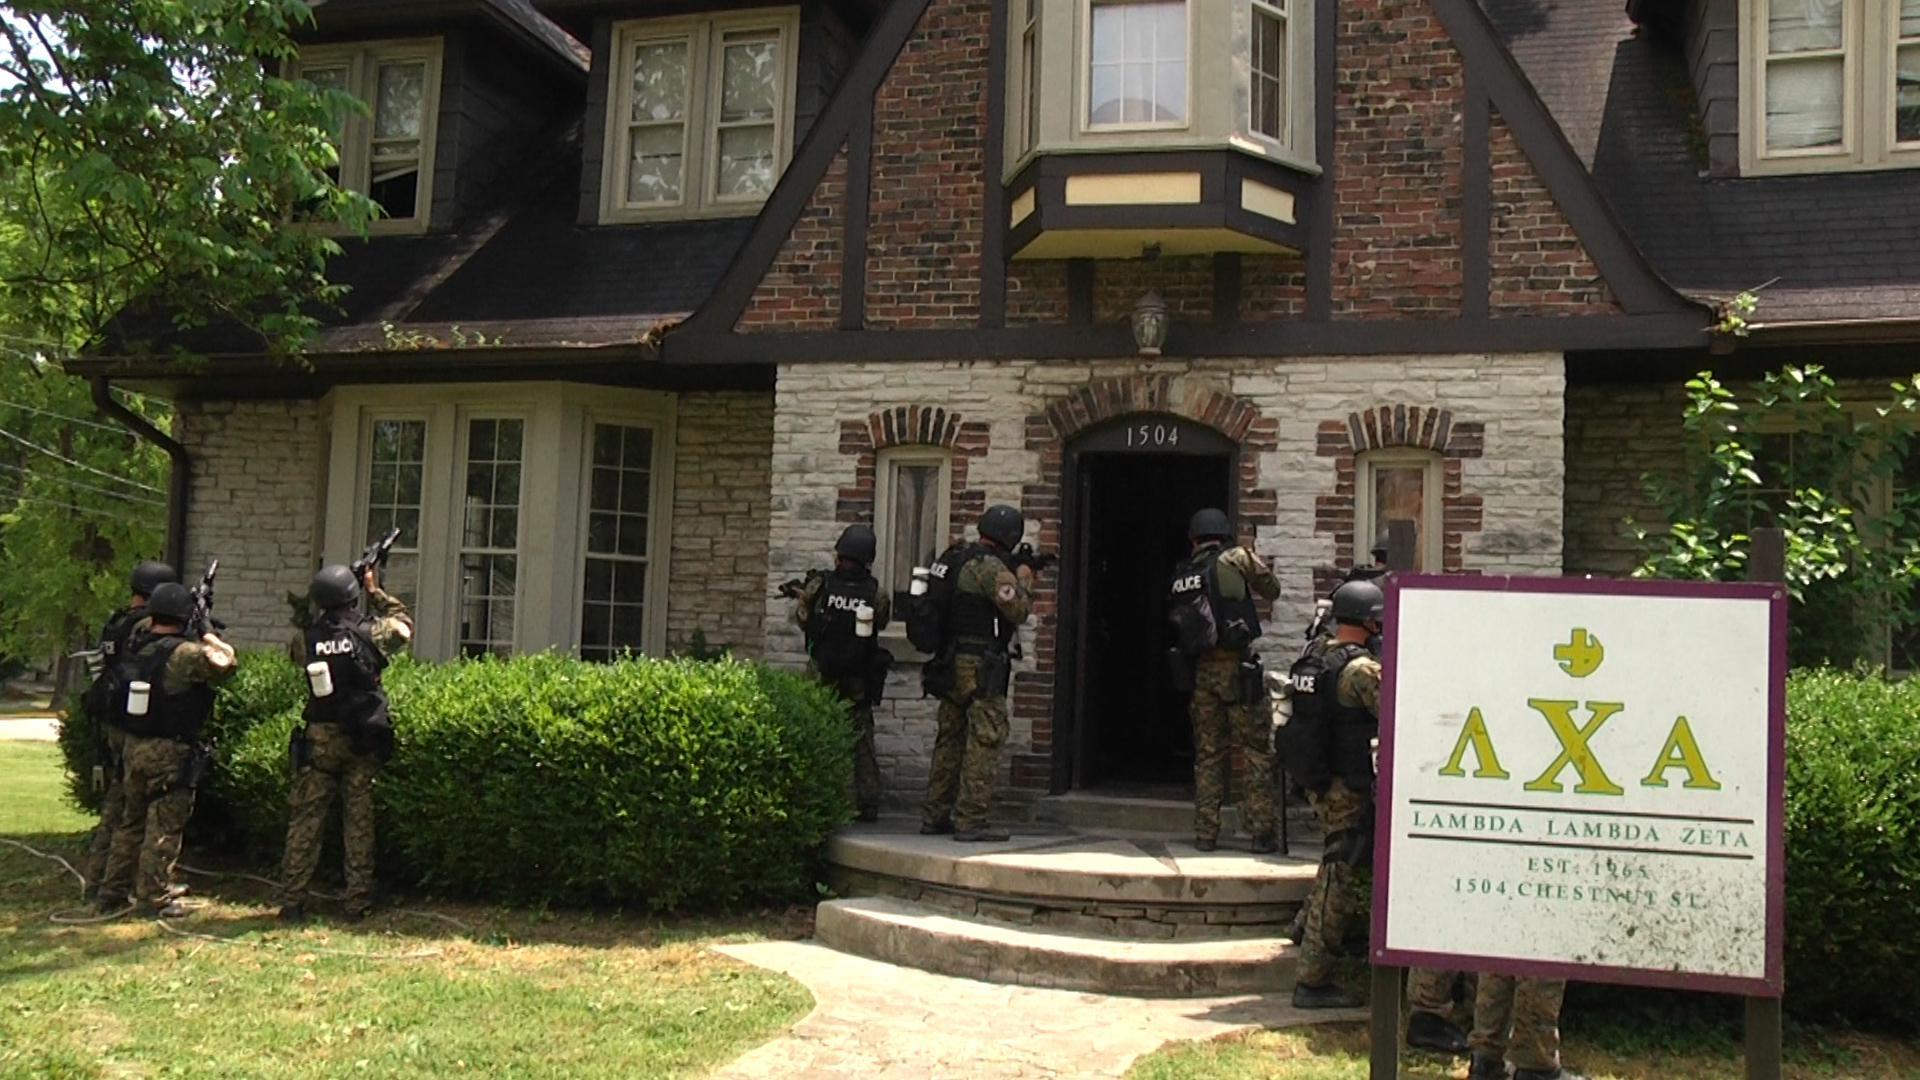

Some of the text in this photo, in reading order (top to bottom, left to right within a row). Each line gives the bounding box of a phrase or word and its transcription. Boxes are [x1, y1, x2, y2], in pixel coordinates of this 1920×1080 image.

[1127, 425, 1178, 447] 1504
[315, 637, 353, 656] POLIC
[1413, 811, 1749, 848] LAMBDA LAMBDA ZETA
[1528, 857, 1580, 876] EST.
[1455, 878, 1506, 895] 1504
[1517, 881, 1656, 906] CHESTNUT
